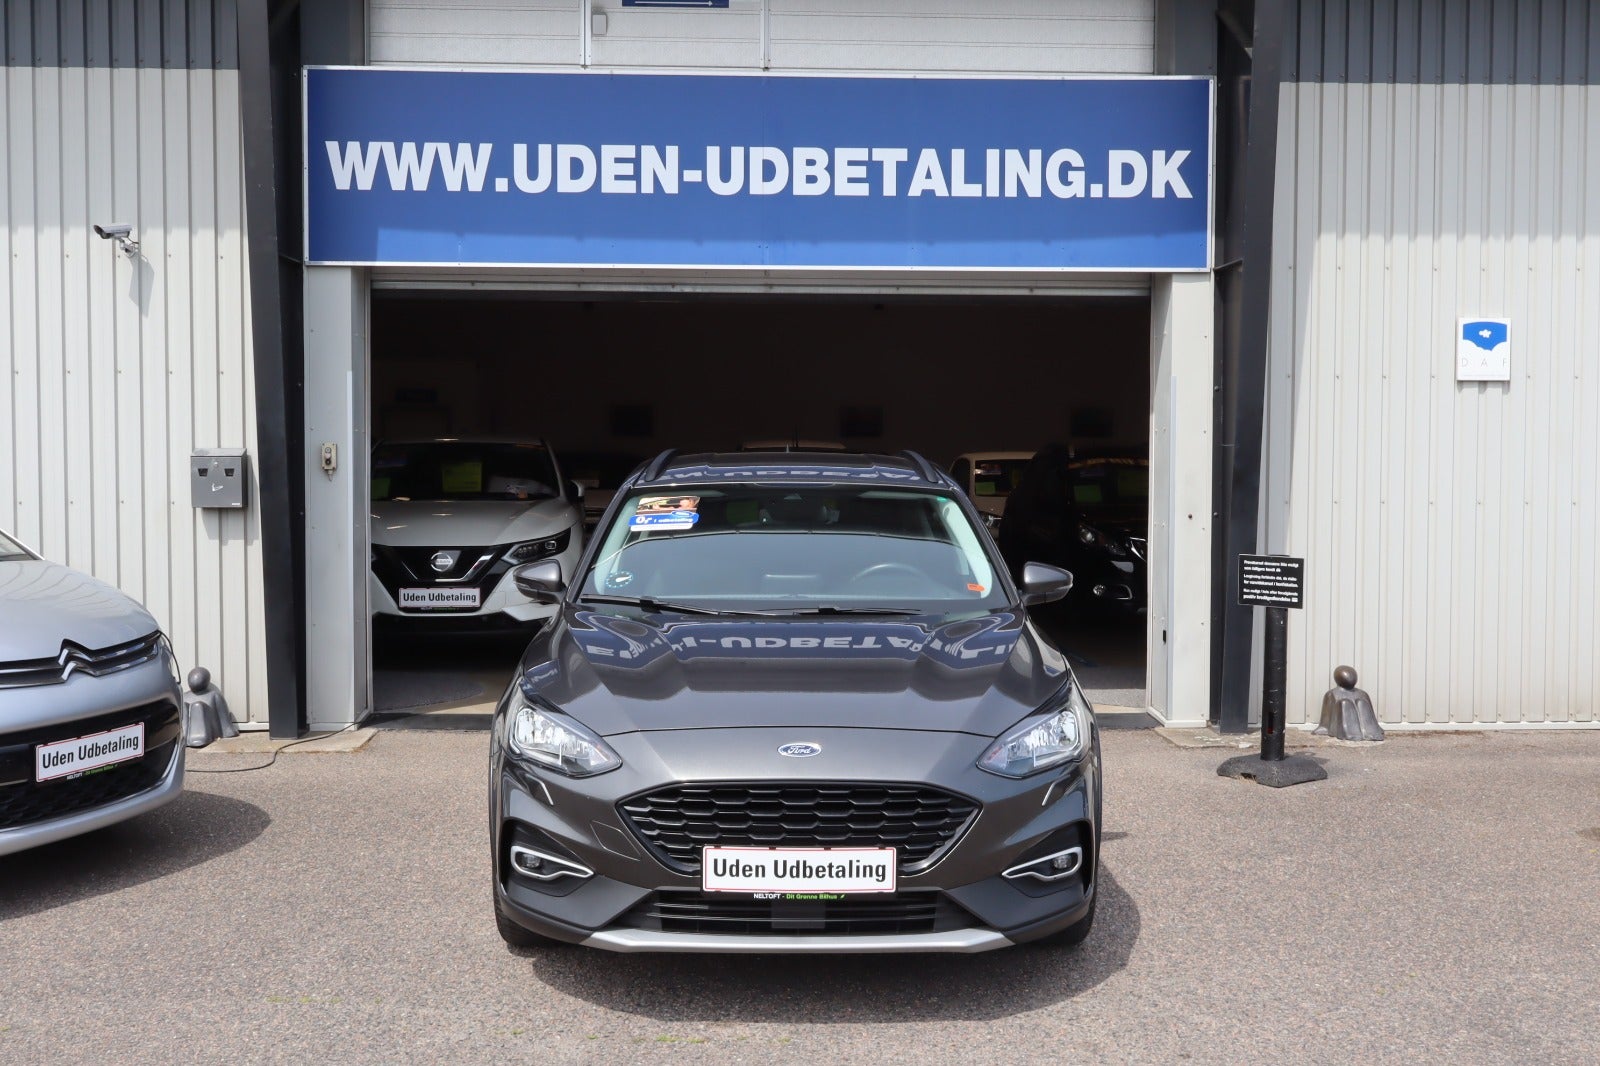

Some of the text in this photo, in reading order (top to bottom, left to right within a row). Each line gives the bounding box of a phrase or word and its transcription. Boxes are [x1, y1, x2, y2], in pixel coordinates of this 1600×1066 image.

[325, 140, 1193, 199] WWW.UDEN-UDBETALING.DK
[403, 593, 477, 603] Uden Udbetaling
[42, 735, 139, 769] Uden Udbetaling
[788, 745, 812, 754] Ford
[713, 858, 887, 883] Uden Udbetaling
